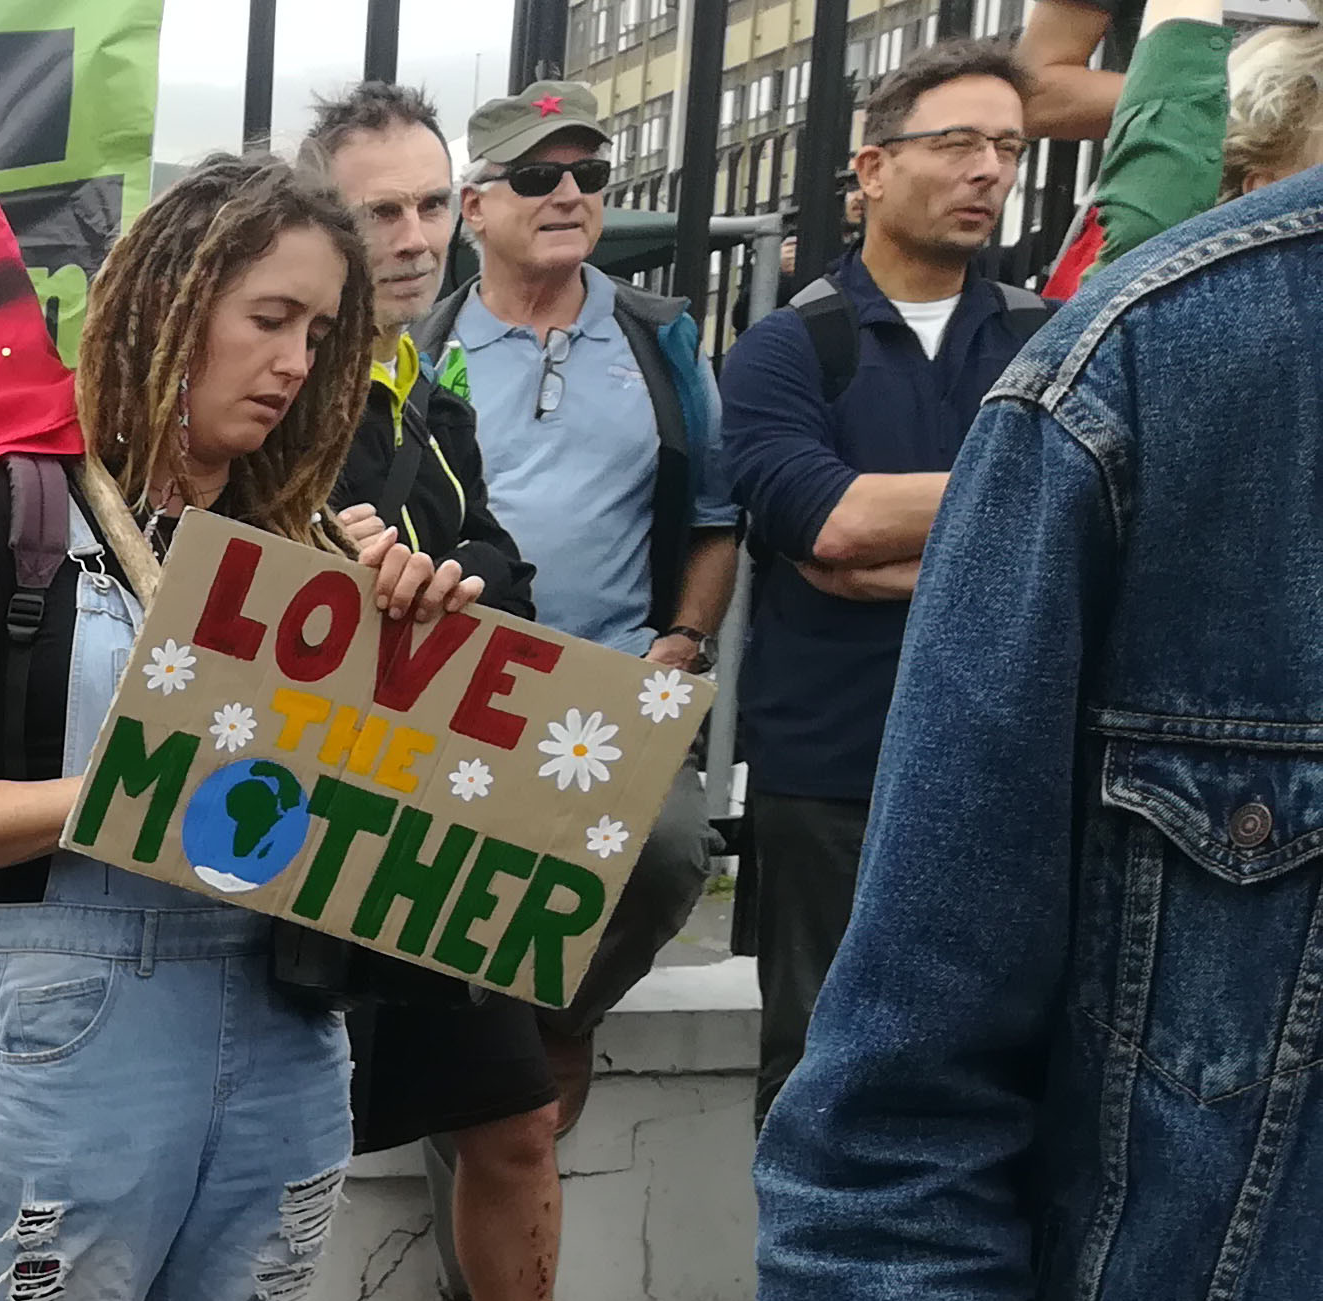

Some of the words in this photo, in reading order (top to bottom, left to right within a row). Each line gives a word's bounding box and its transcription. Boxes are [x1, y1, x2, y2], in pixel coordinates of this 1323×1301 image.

[192, 538, 564, 751] LOVE
[269, 687, 437, 793] THE
[71, 715, 606, 1008] MOTHER
